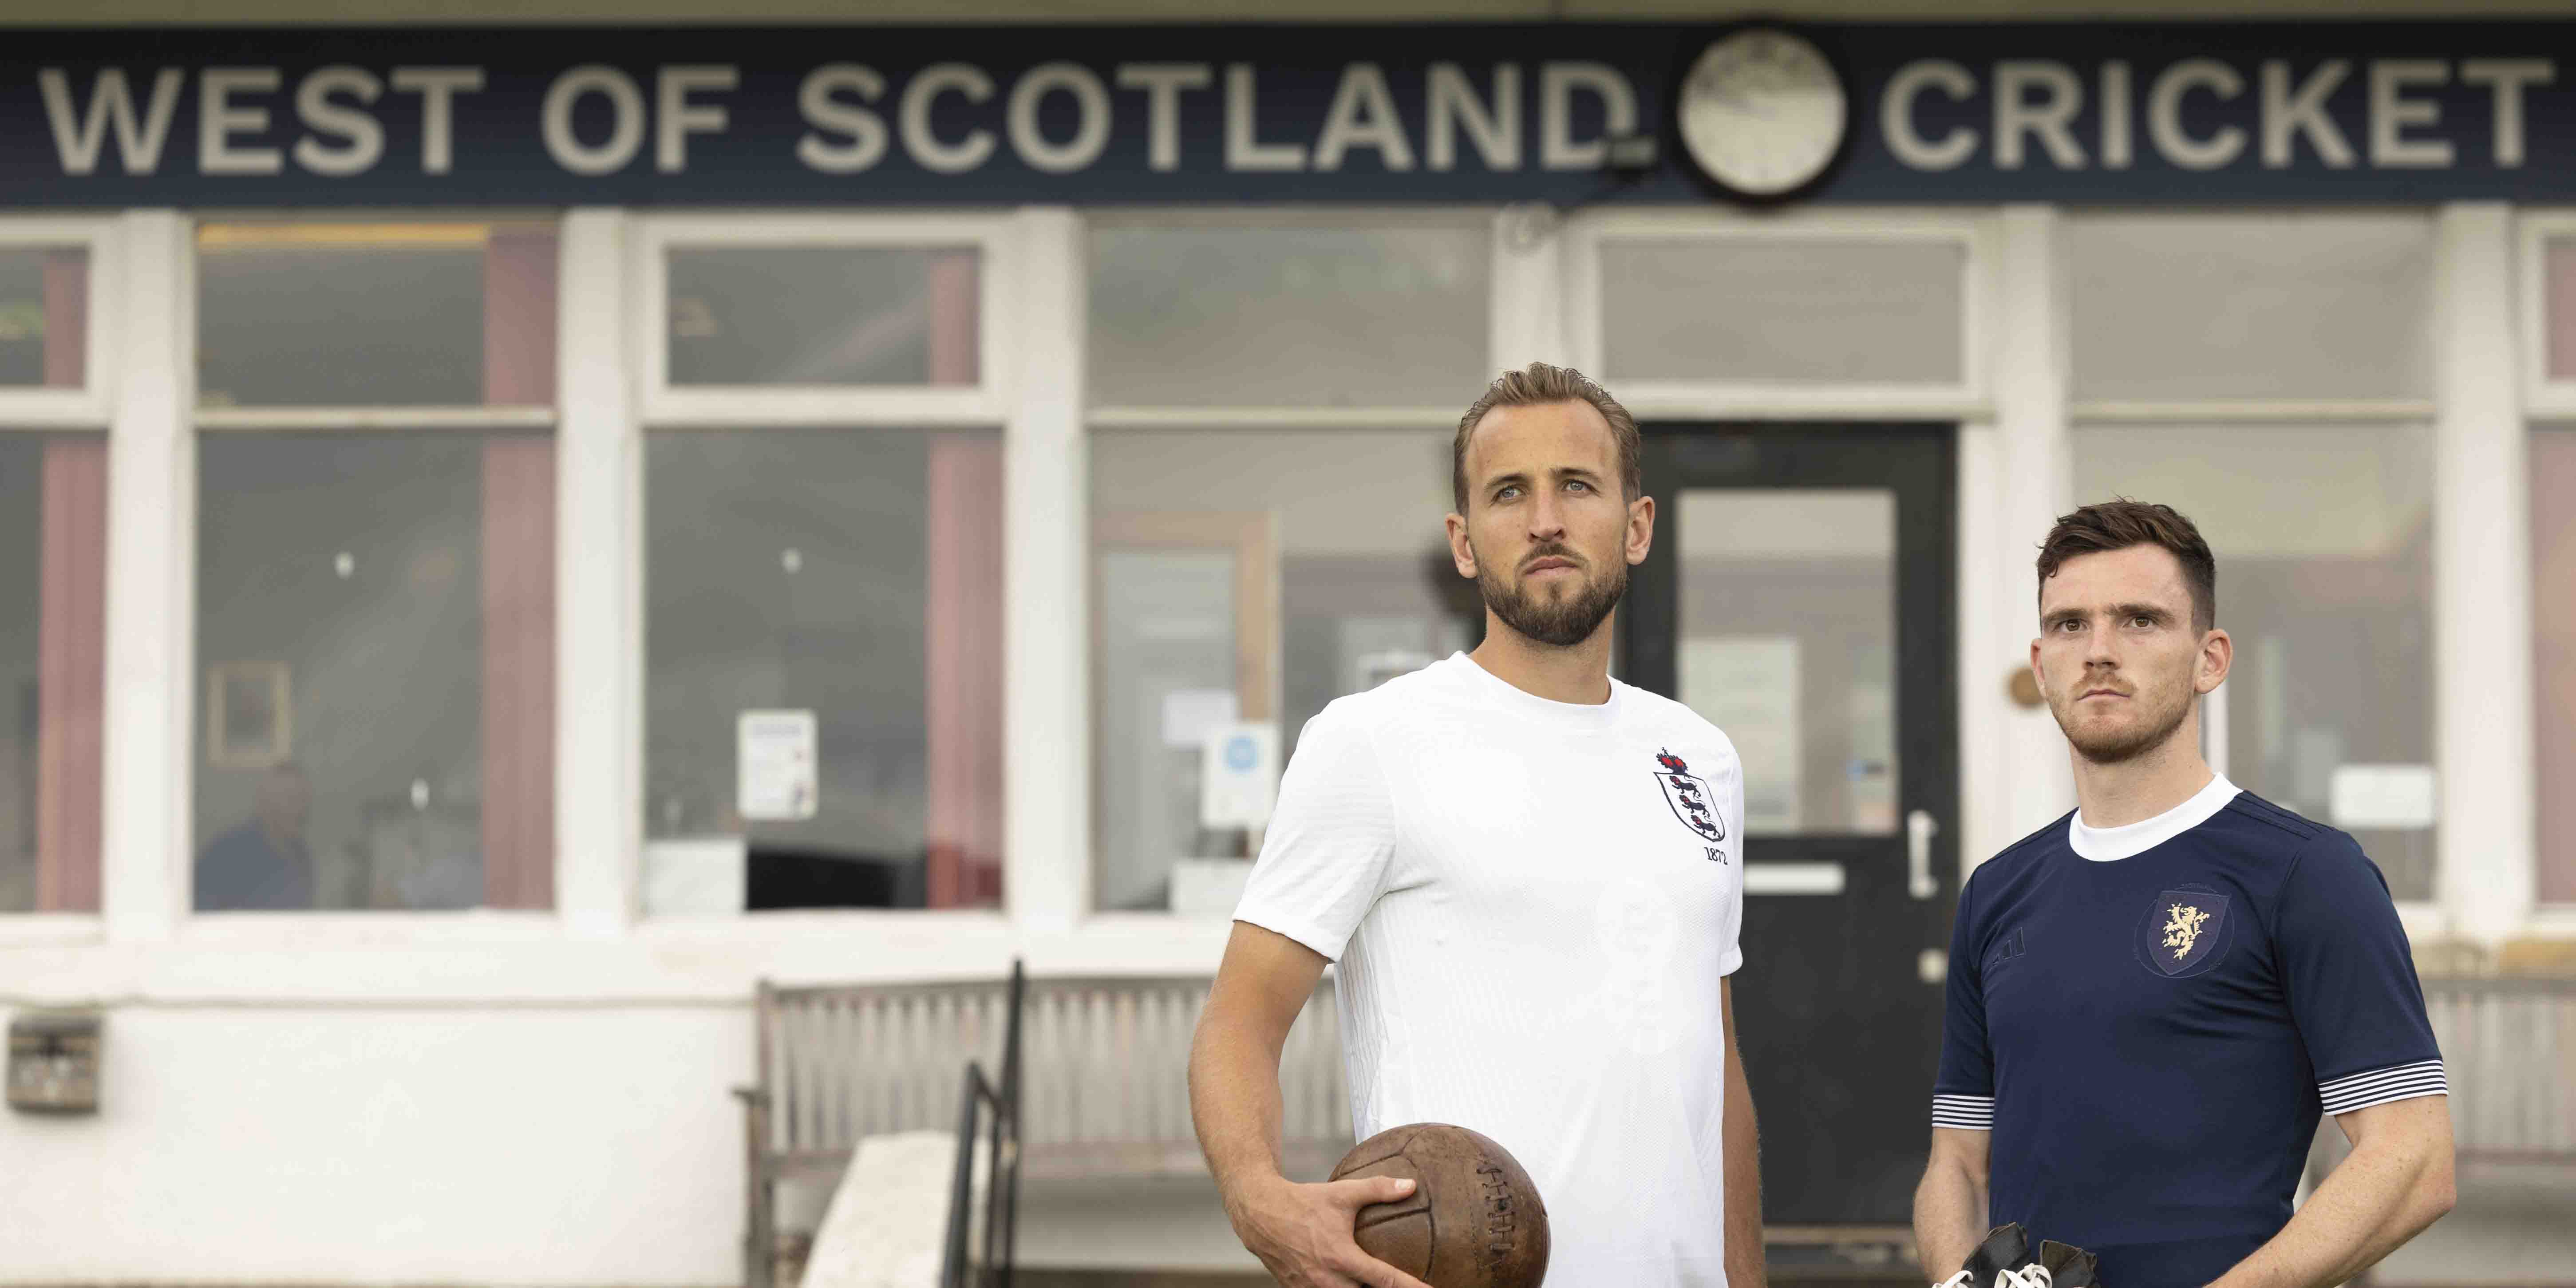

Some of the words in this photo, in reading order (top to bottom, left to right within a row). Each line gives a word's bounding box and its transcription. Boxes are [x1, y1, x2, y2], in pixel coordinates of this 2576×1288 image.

[40, 67, 485, 176] WEST
[541, 65, 739, 175] OF
[797, 63, 1638, 173] SCOTLAND
[1879, 60, 2555, 170] CRICKET
[1704, 847, 1728, 865] 1872
